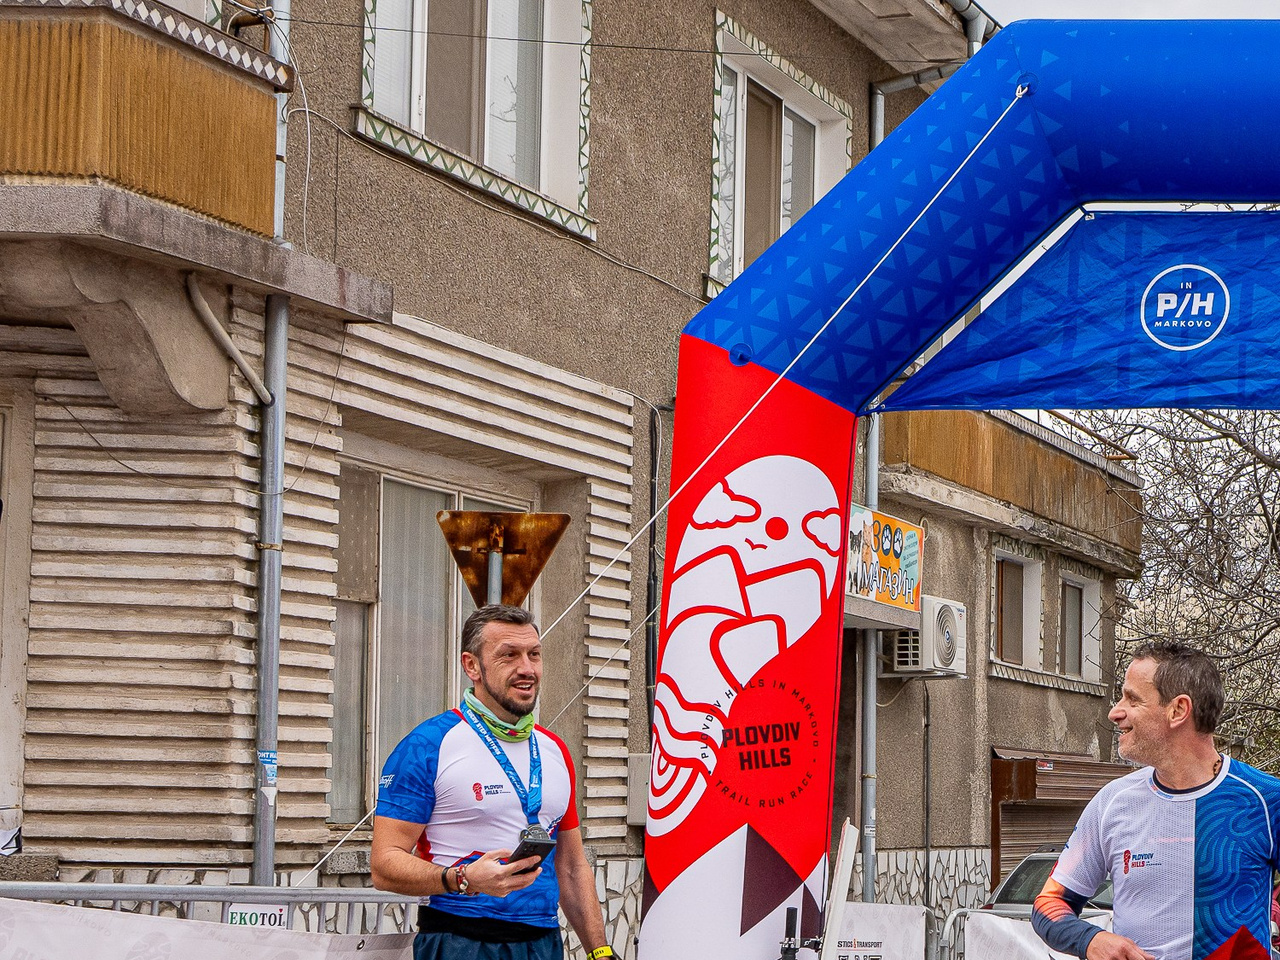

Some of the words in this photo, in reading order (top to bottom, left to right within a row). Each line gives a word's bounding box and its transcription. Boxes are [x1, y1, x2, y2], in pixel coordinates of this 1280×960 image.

[1156, 292, 1215, 318] P/H
[1154, 320, 1212, 328] MARKOVO
[860, 561, 915, 605] МАГАЗИН
[700, 700, 722, 759] PLOVDIV
[725, 679, 765, 699] HILLS
[773, 680, 786, 690] IN
[791, 688, 819, 747] MARKOVO
[721, 722, 800, 748] PLOVDIV
[738, 747, 791, 771] HILLS
[715, 780, 750, 806] TRAIL
[759, 797, 785, 808] RUN
[790, 772, 813, 799] RACE
